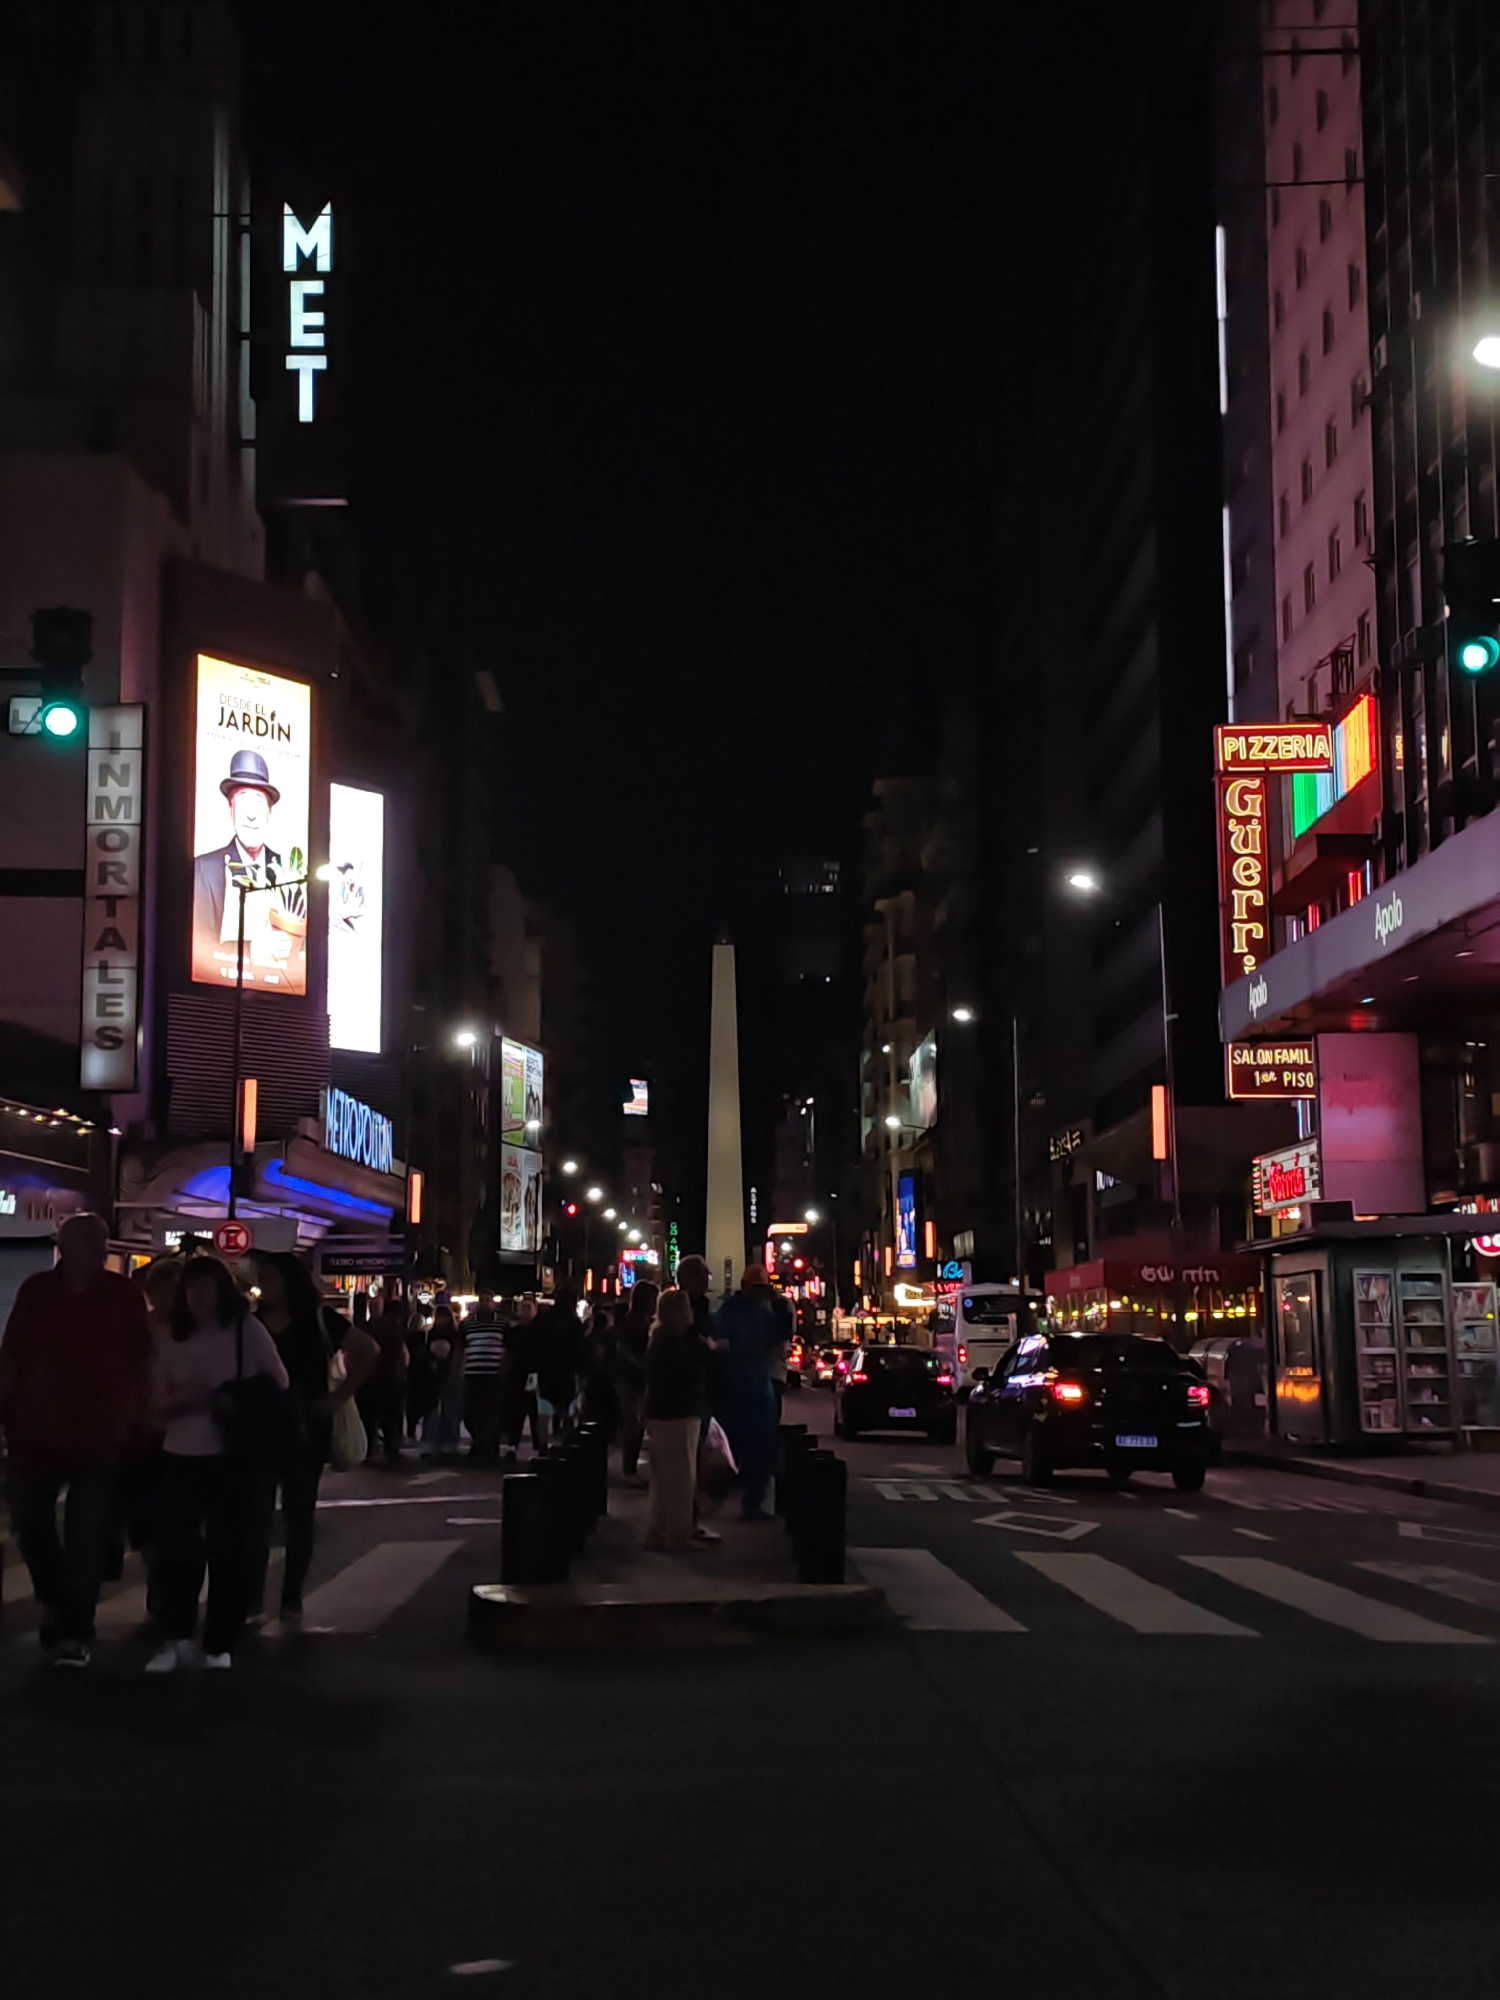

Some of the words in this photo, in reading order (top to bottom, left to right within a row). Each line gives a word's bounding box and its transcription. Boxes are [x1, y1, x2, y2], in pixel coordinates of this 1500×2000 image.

[283, 200, 332, 423] MET
[219, 693, 251, 712] DESDE
[255, 703, 267, 716] EL
[1224, 734, 1330, 761] PIZZERIA
[93, 731, 132, 1051] INMORTALES
[1375, 890, 1403, 946] Apolo
[1249, 974, 1267, 1019] Apolo
[1233, 1049, 1273, 1065] SALON
[1274, 1048, 1313, 1065] FAMIL
[1282, 1071, 1315, 1088] PISO
[325, 1086, 393, 1175] METROPOLITAN
